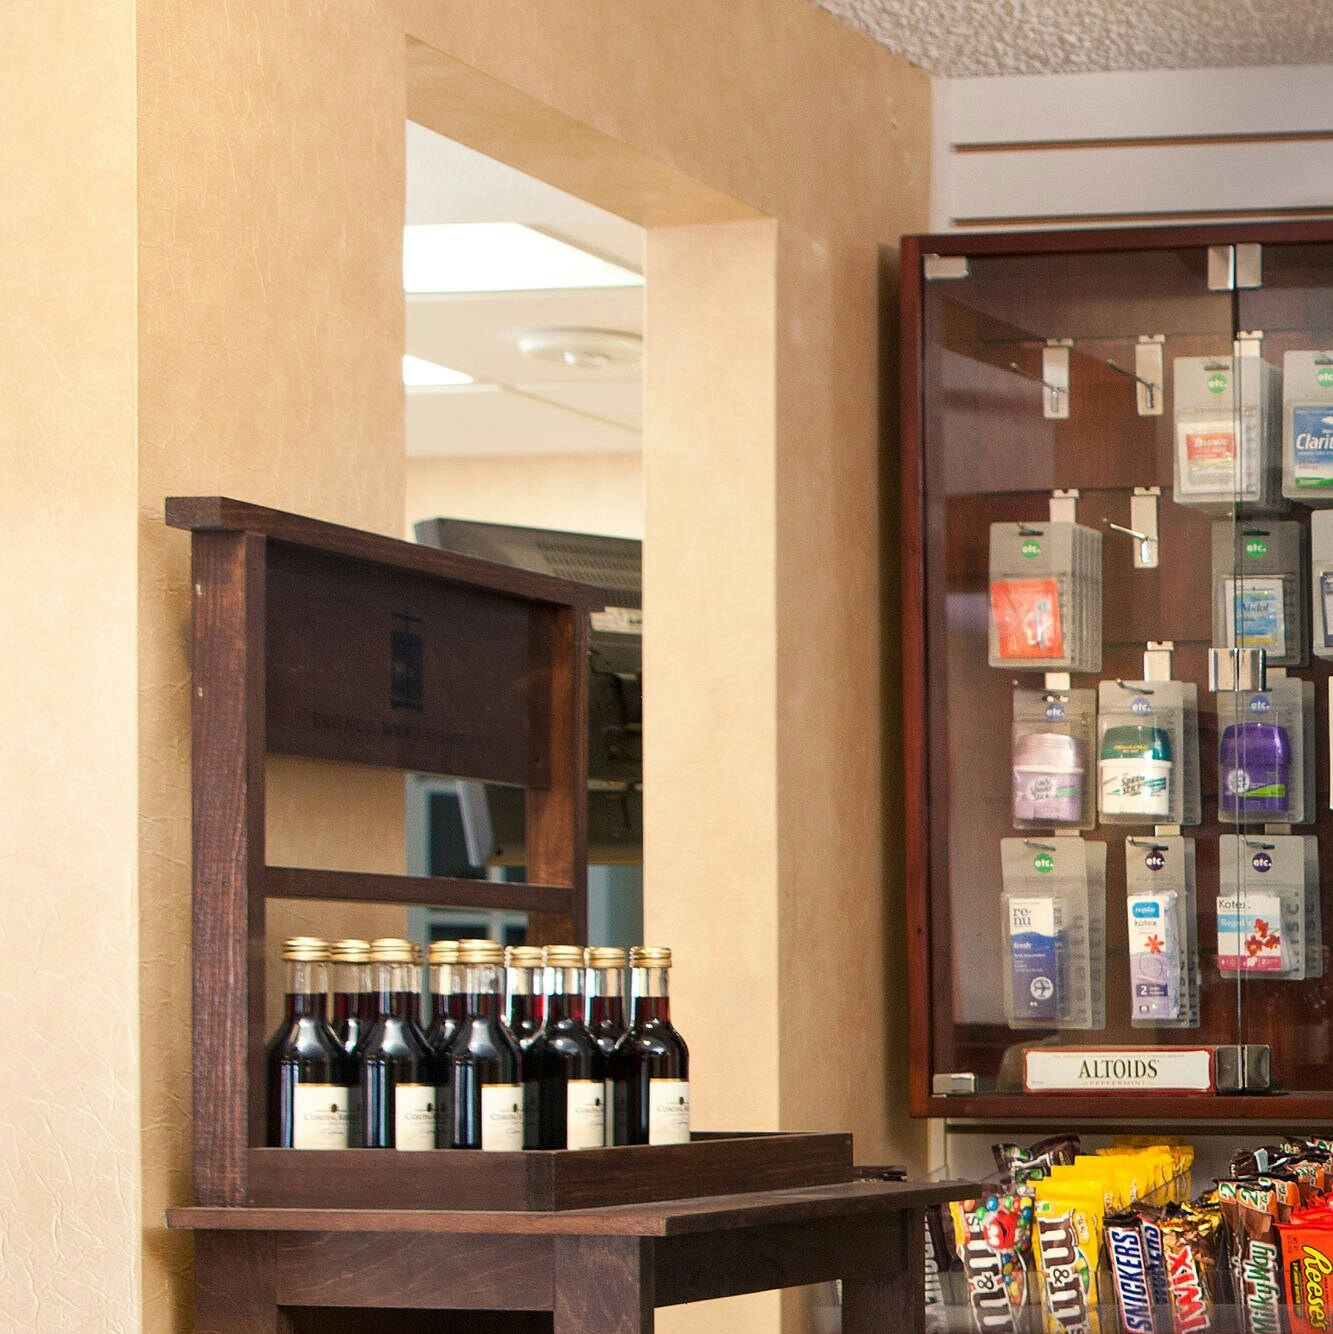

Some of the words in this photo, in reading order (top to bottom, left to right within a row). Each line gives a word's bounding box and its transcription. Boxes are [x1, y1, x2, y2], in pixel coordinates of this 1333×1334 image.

[1207, 378, 1228, 389] etc.
[1021, 544, 1041, 554] etc.
[1246, 543, 1266, 552] etc.
[1079, 1059, 1158, 1079] ALTOIDS
[1111, 1230, 1152, 1333] SNICKERS
[1167, 1246, 1210, 1334] TWIX
